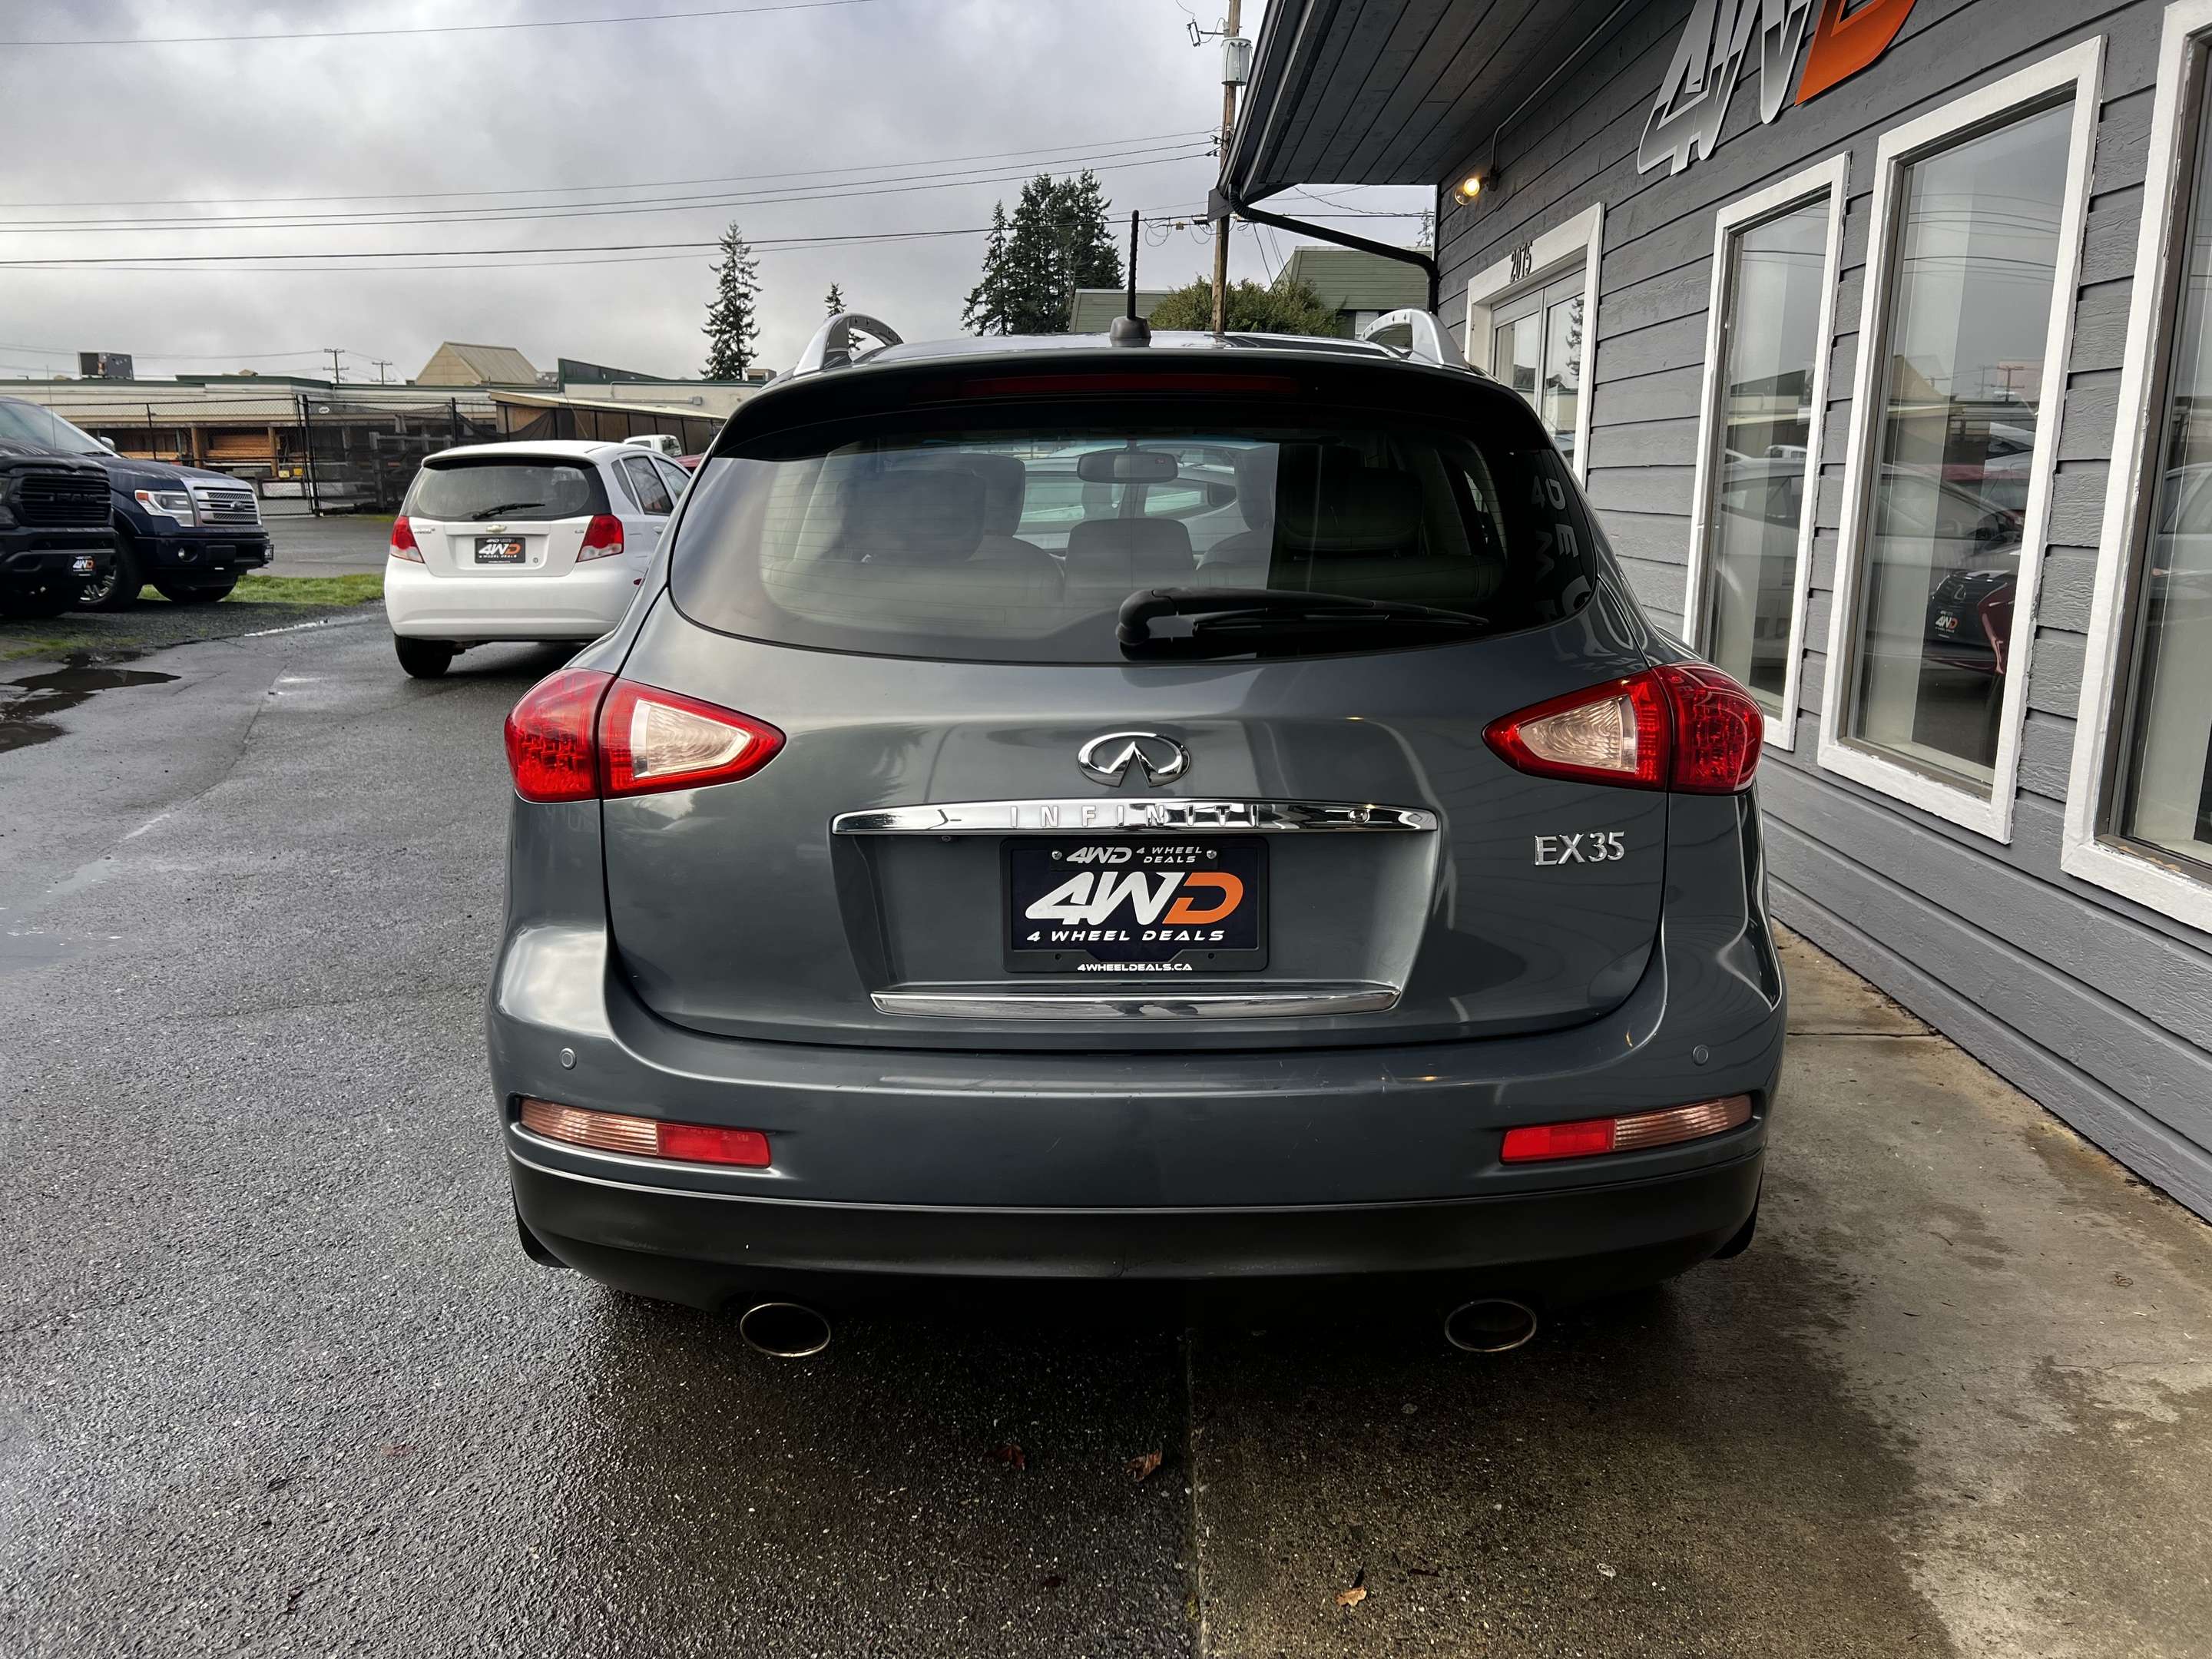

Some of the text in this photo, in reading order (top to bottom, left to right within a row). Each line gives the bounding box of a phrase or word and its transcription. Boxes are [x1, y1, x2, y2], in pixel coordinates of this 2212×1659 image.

[478, 543, 522, 555] 4WD
[1935, 615, 1959, 629] 4WD
[1011, 805, 1258, 827] INFINITI
[1066, 846, 1132, 864] 4WD
[1025, 872, 1243, 926] 4WD
[1027, 930, 1225, 942] 4 WHEEL DEALS
[1077, 963, 1193, 972] 4WHEELDEALS.CA
